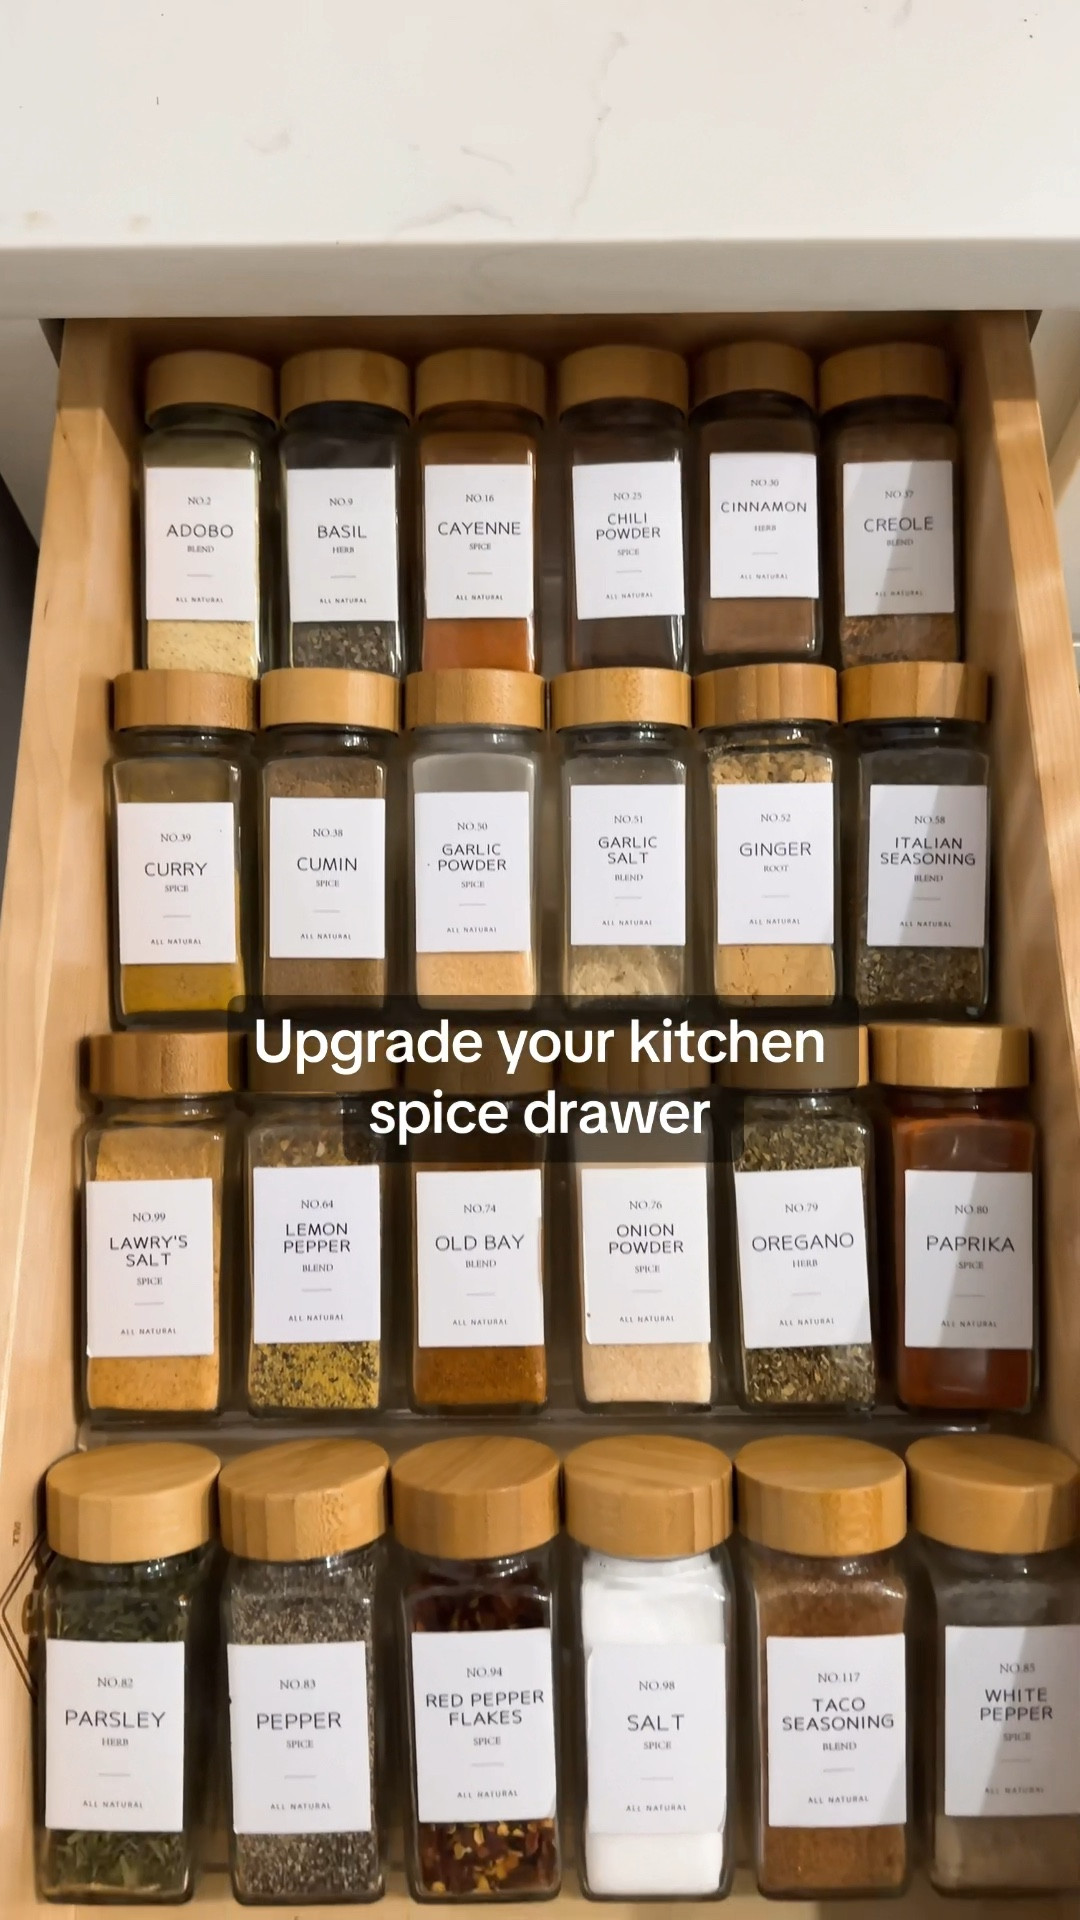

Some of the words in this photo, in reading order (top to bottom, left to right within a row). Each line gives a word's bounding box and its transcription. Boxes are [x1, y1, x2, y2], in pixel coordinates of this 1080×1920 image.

[721, 501, 806, 513] CINNAMON
[608, 512, 647, 525] CHILI
[438, 522, 520, 535] CAYENNE
[754, 524, 776, 532] HERB
[864, 516, 933, 533] CREOLE
[166, 524, 233, 538] ADOBO
[318, 525, 367, 539] BASIL
[596, 527, 660, 540] POWDER
[886, 538, 914, 547] BLEND
[187, 545, 214, 553] BLEND
[333, 546, 354, 554] HERB
[617, 548, 639, 556] SPICE
[739, 573, 753, 581] ALL
[755, 572, 789, 580] NATURAL
[470, 593, 504, 601] NATURAL
[605, 593, 618, 601] ALL
[620, 591, 653, 600] NATURAL
[889, 589, 924, 598] NATURAL
[175, 596, 188, 604] ALL
[190, 596, 224, 604] NATURAL
[319, 597, 332, 605] ALL
[334, 597, 367, 605] NATURAL
[614, 815, 643, 824] NO.51
[761, 813, 791, 822] NO.52
[915, 816, 945, 824] NO.58
[313, 828, 343, 837] NO.38
[161, 833, 191, 843] NO.39
[598, 836, 656, 849] GARLIC
[896, 837, 962, 850] ITALIAN
[442, 844, 500, 856] GARLIC
[740, 842, 811, 857] GINGER
[608, 852, 648, 864] SALT
[881, 852, 975, 866] SEASONING
[297, 857, 357, 871] CUMIN
[438, 859, 506, 871] POWDER
[764, 864, 789, 872] ROOT
[145, 862, 207, 877] CURRY
[615, 873, 643, 882] BLEND
[914, 874, 943, 883] BLEND
[165, 884, 188, 892] SPICE
[461, 880, 485, 888] SPICE
[601, 919, 615, 927] ALL
[618, 919, 653, 927] NATURAL
[748, 918, 763, 926] ALL
[765, 917, 801, 926] NATURAL
[899, 920, 915, 928] ALL
[916, 920, 952, 928] NATURAL
[446, 926, 460, 934] ALL
[463, 925, 497, 934] NATURAL
[150, 938, 164, 946] ALL
[167, 937, 202, 946] NATURAL
[300, 932, 314, 941] ALL
[316, 932, 352, 941] NATURAL
[301, 1200, 333, 1209] NO.64
[464, 1204, 496, 1213] NO.74
[629, 1200, 662, 1210] NO.76
[785, 1203, 818, 1213] NO.79
[955, 1204, 988, 1214] NO.80
[133, 1212, 166, 1222] NO.99
[286, 1223, 347, 1236] LEMON
[617, 1224, 674, 1238] ONION
[110, 1235, 187, 1250] LAWRY'S
[284, 1239, 350, 1254] PEPPER
[435, 1235, 477, 1251] OLD
[485, 1235, 524, 1251] BAY
[609, 1240, 683, 1255] POWDER
[752, 1233, 854, 1252] OREGANO
[927, 1235, 1015, 1252] PAPRIKA
[126, 1252, 171, 1267] SALT
[466, 1259, 496, 1268] BLEND
[793, 1259, 818, 1268] HERB
[303, 1264, 333, 1272] BLEND
[635, 1265, 660, 1274] SPICE
[958, 1260, 984, 1270] SPICE
[137, 1277, 162, 1286] SPICE
[288, 1314, 305, 1323] ALL
[306, 1313, 344, 1322] NATURAL
[452, 1318, 467, 1327] ALL
[470, 1317, 508, 1326] NATURAL
[619, 1315, 634, 1324] ALL
[637, 1314, 675, 1324] NATURAL
[778, 1319, 794, 1328] ALL
[797, 1317, 835, 1327] NATURAL
[940, 1319, 956, 1329] ALL
[959, 1319, 998, 1329] NATURAL
[120, 1328, 135, 1337] ALL
[138, 1327, 177, 1336] NATURAL
[467, 1667, 502, 1678] NO.94
[818, 1672, 860, 1683] NO.117
[97, 1677, 133, 1689] NO.82
[280, 1679, 316, 1690] NO.83
[639, 1680, 675, 1691] NO.98
[426, 1694, 463, 1708] RED
[471, 1690, 544, 1707] PEPPER
[985, 1688, 1046, 1703] WHITE
[813, 1697, 865, 1712] TACO
[66, 1709, 165, 1728] PARSLEY
[449, 1709, 522, 1726] FLAKES
[980, 1706, 1053, 1721] PEPPER
[257, 1712, 341, 1730] PEPPER
[628, 1714, 684, 1731] SALT
[782, 1714, 894, 1731] SEASONING
[102, 1737, 129, 1747] HERB
[473, 1736, 501, 1746] SPICE
[1003, 1732, 1031, 1742] SPICE
[286, 1739, 313, 1749] SPICE
[644, 1741, 671, 1750] SPICE
[823, 1741, 857, 1751] BLEND
[456, 1791, 473, 1800] ALL
[476, 1789, 519, 1800] NATURAL
[984, 1787, 1000, 1796] ALL
[1004, 1785, 1045, 1795] NATURAL
[82, 1799, 98, 1809] ALL
[101, 1800, 143, 1810] NATURAL
[807, 1796, 824, 1805] ALL
[827, 1794, 870, 1805] NATURAL
[270, 1802, 286, 1811] ALL
[289, 1801, 332, 1811] NATURAL
[625, 1804, 642, 1813] ALL
[645, 1803, 687, 1813] NATURAL
